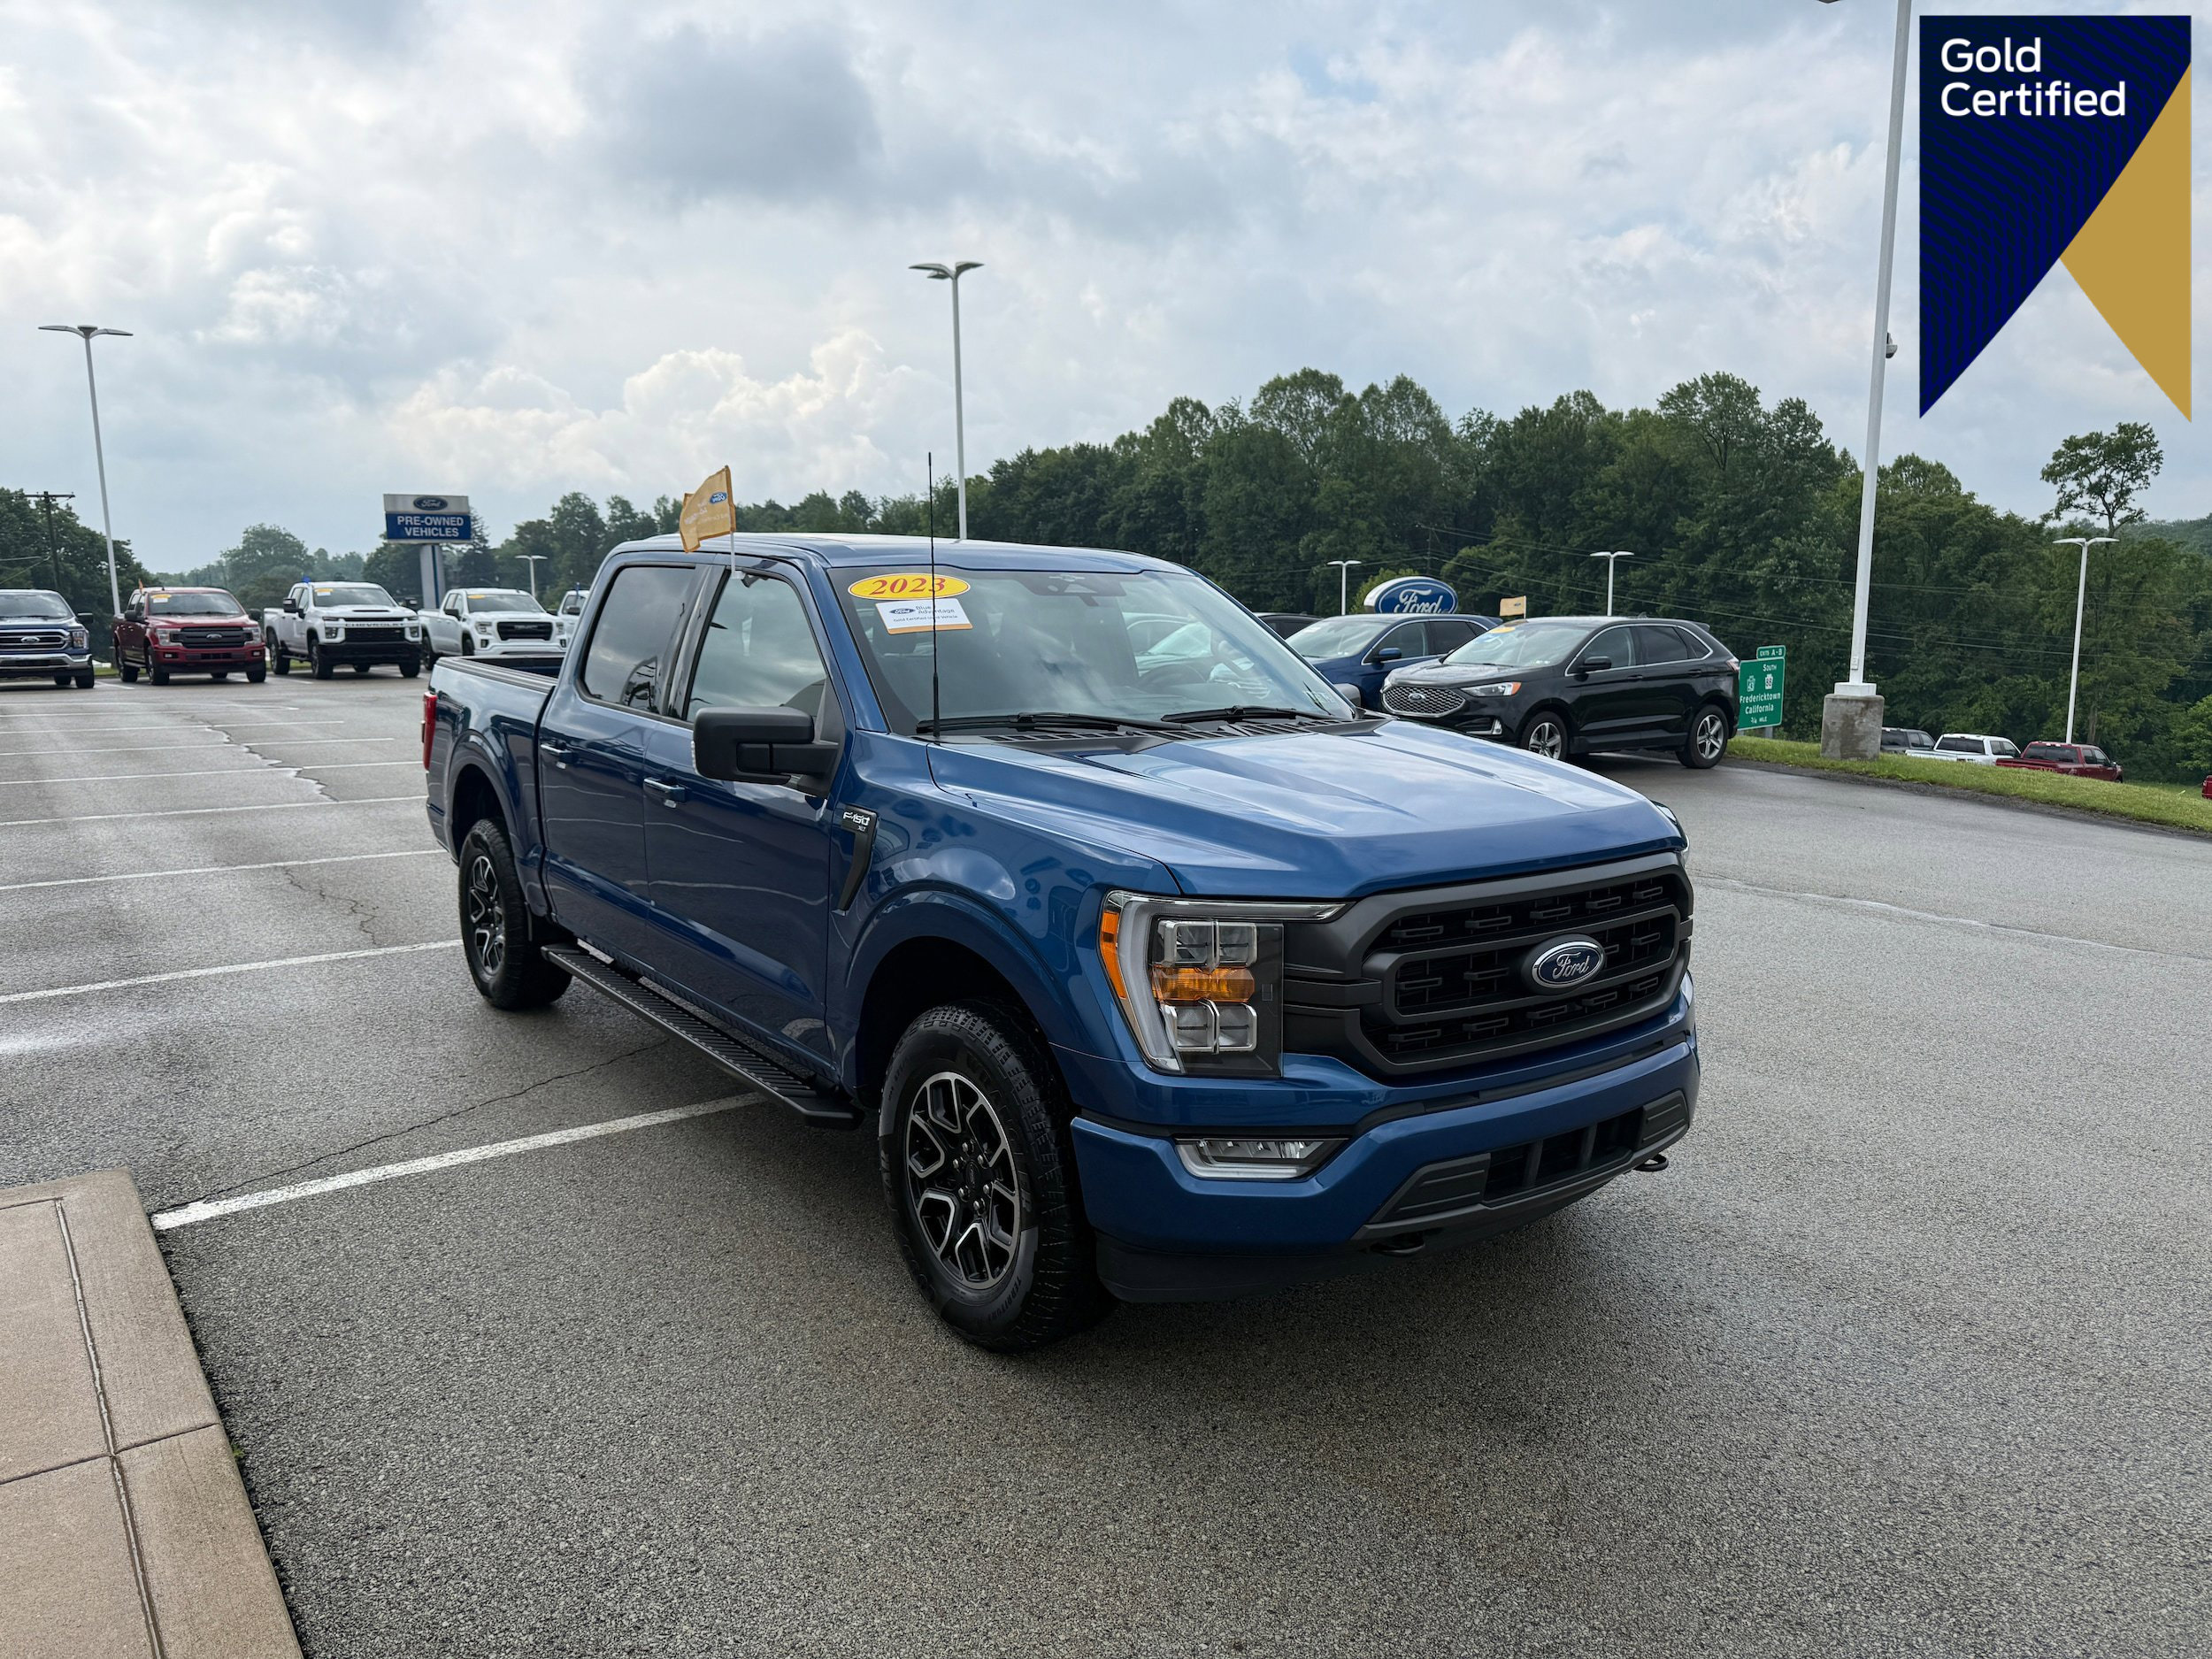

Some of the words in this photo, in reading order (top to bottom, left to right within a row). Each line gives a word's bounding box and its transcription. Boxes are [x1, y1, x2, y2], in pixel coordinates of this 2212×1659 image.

[396, 516, 464, 526] PRE-OWNED
[404, 527, 459, 537] VEHICLES
[869, 577, 946, 595] 2023
[1394, 588, 1443, 613] Ford
[1740, 692, 1781, 704] Fredericktown
[1745, 703, 1774, 714] California
[843, 811, 871, 826] F-150
[1552, 951, 1591, 979] Ford
